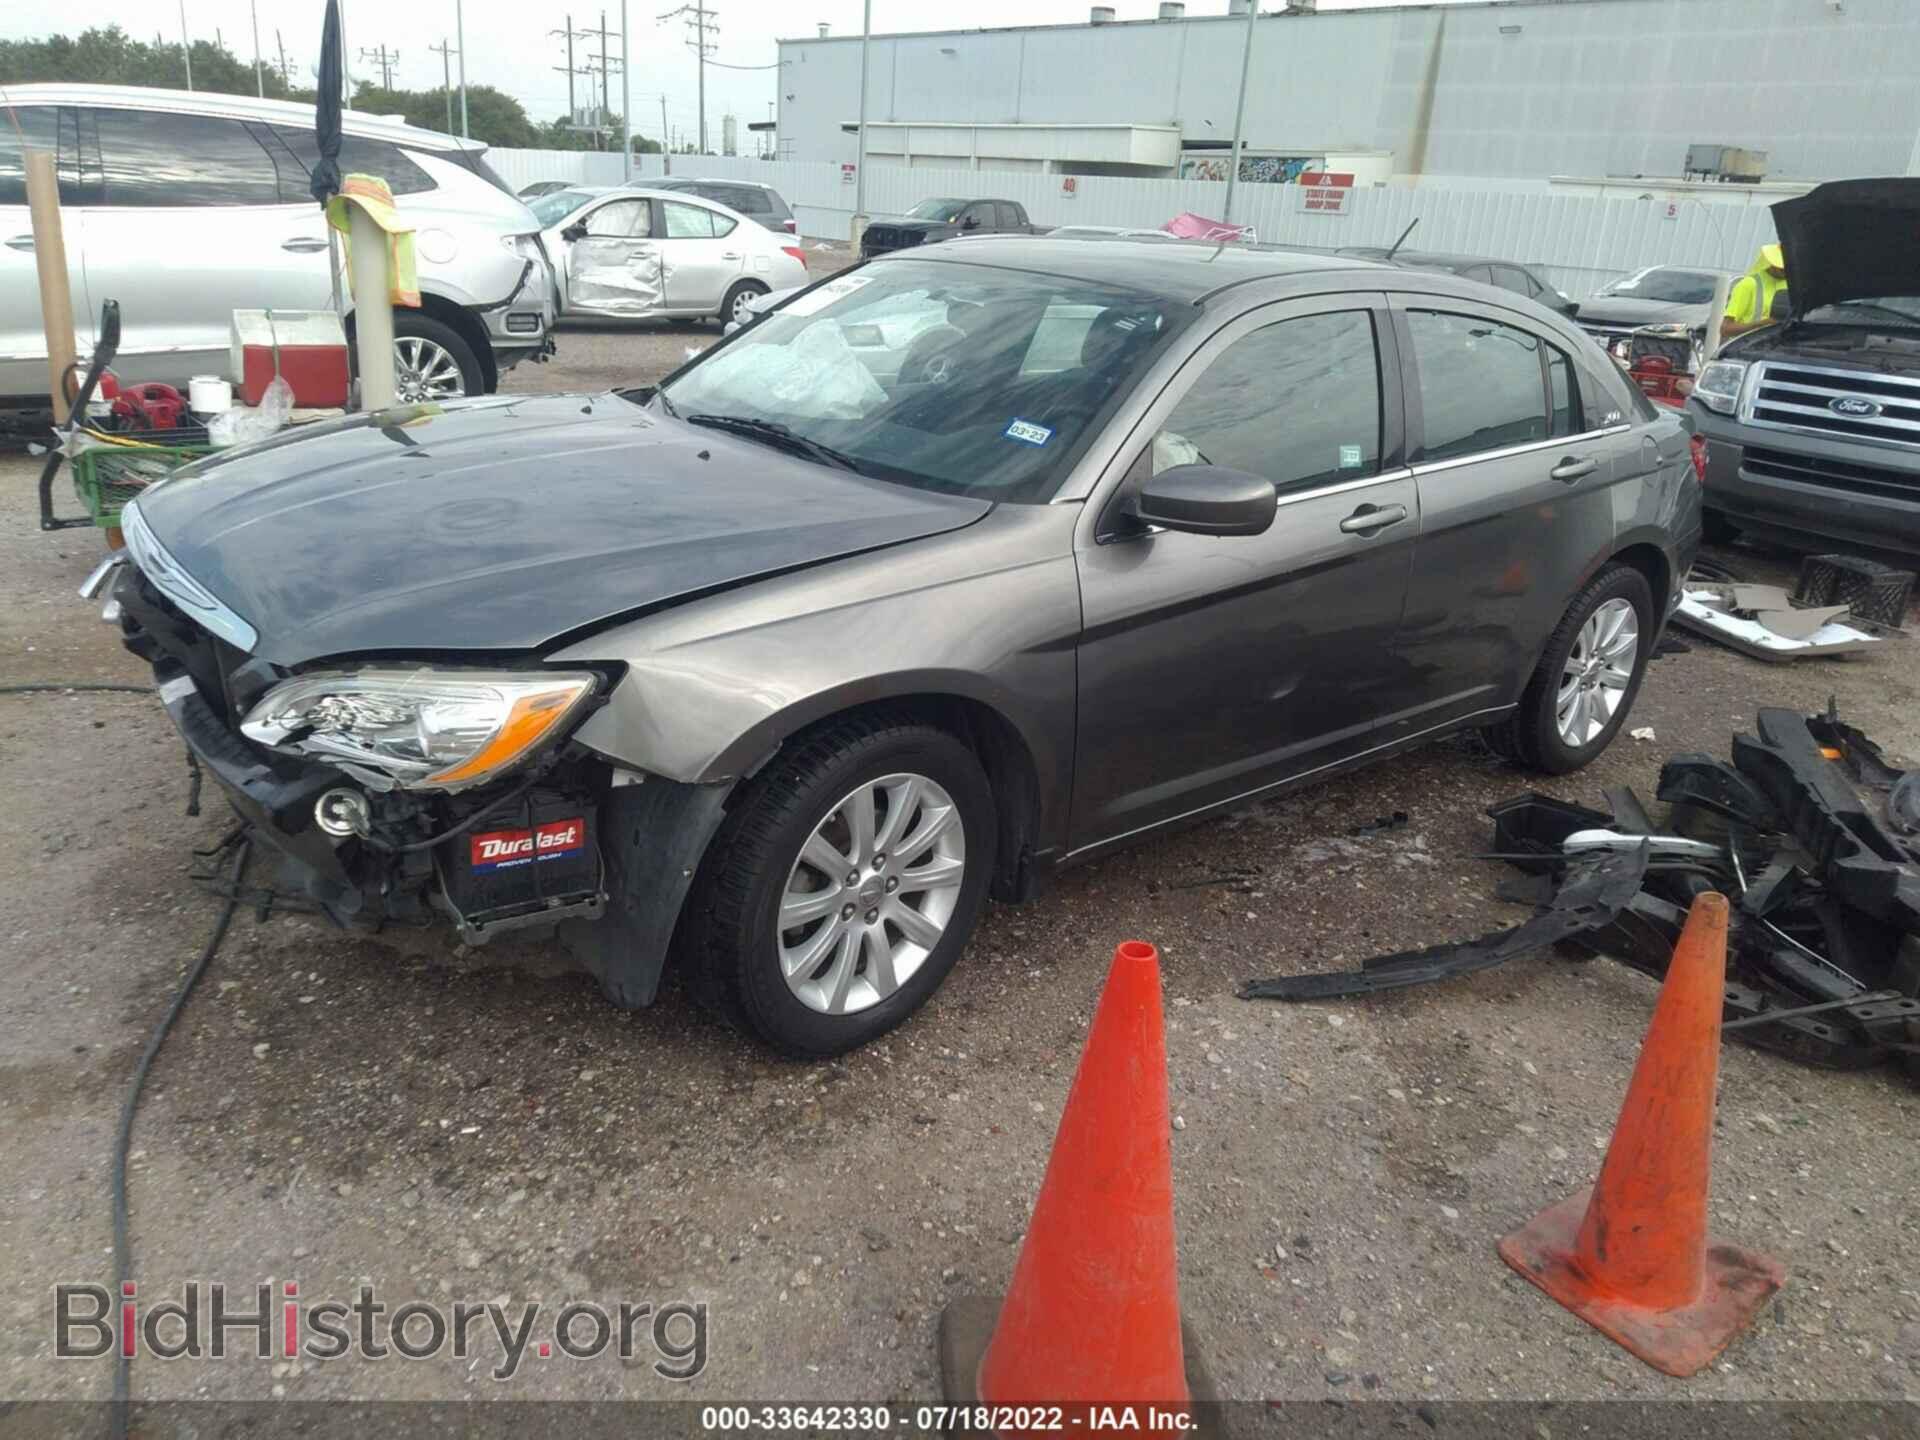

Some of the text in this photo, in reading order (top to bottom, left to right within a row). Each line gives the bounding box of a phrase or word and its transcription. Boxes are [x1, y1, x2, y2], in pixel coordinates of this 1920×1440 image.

[1063, 178, 1076, 192] 40
[1839, 400, 1870, 413] Ford
[536, 852, 562, 861] OUGH
